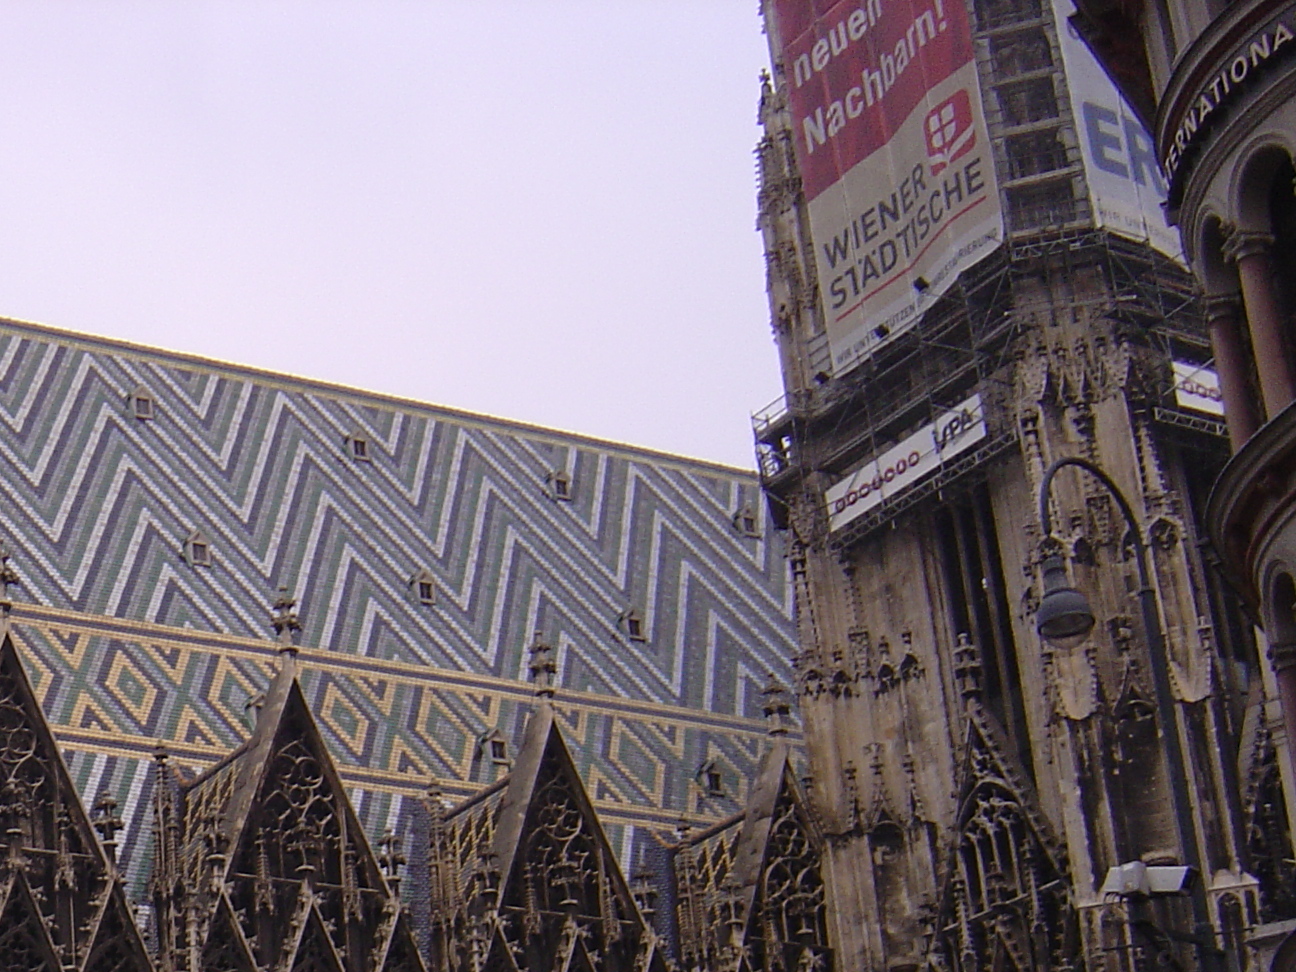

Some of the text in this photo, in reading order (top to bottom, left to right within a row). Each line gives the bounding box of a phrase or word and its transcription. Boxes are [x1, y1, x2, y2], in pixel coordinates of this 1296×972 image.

[793, 0, 882, 87] neuen
[802, 0, 947, 154] Nachbarn!
[823, 163, 926, 270] WIENER
[830, 157, 985, 310] STÄDTISCHE
